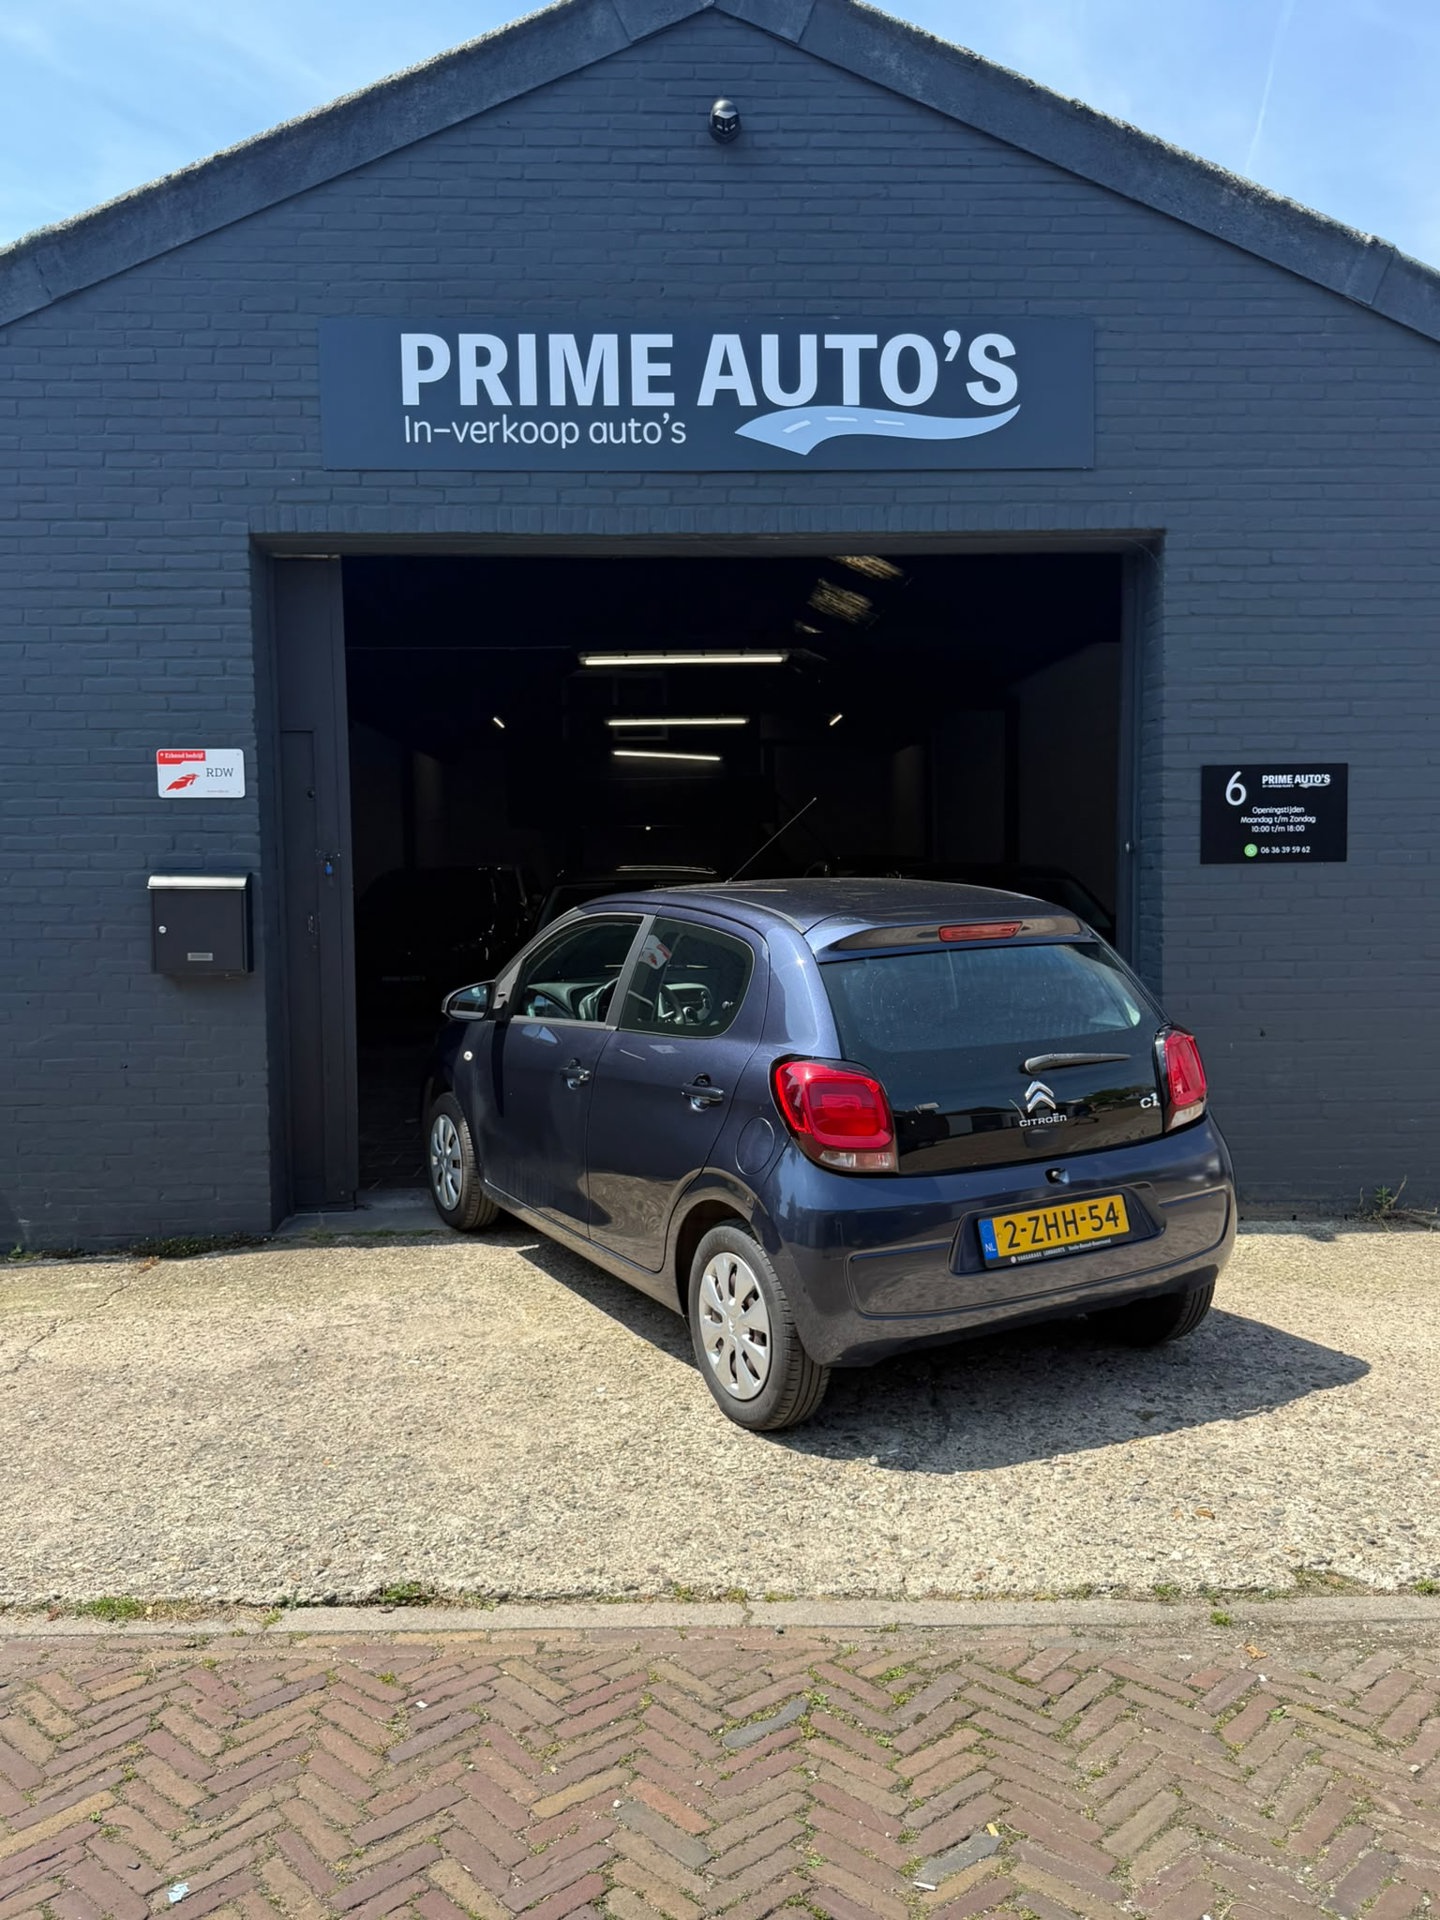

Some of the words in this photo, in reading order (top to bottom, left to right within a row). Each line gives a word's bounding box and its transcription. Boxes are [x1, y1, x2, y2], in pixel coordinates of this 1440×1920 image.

[401, 334, 675, 407] PRIME
[697, 330, 1020, 407] AUTO'S
[404, 414, 580, 449] In-verkoop
[589, 413, 687, 445] auto's
[206, 767, 234, 778] RDW
[1261, 775, 1293, 785] PRIME
[1294, 774, 1331, 784] AUTO'S
[1225, 771, 1247, 806] 6
[1252, 806, 1305, 815] Openingstijden
[1240, 816, 1273, 824] Maandag
[1274, 816, 1289, 824] t/m
[1289, 815, 1317, 824] Zondag
[1251, 825, 1270, 833] 10:00
[1271, 825, 1286, 833] t/m
[1287, 824, 1306, 832] 18:00
[1260, 846, 1270, 854] 06
[1140, 1092, 1161, 1109] C1
[1003, 1201, 1121, 1249] 2-ZHH-54
[985, 1243, 997, 1253] NL
